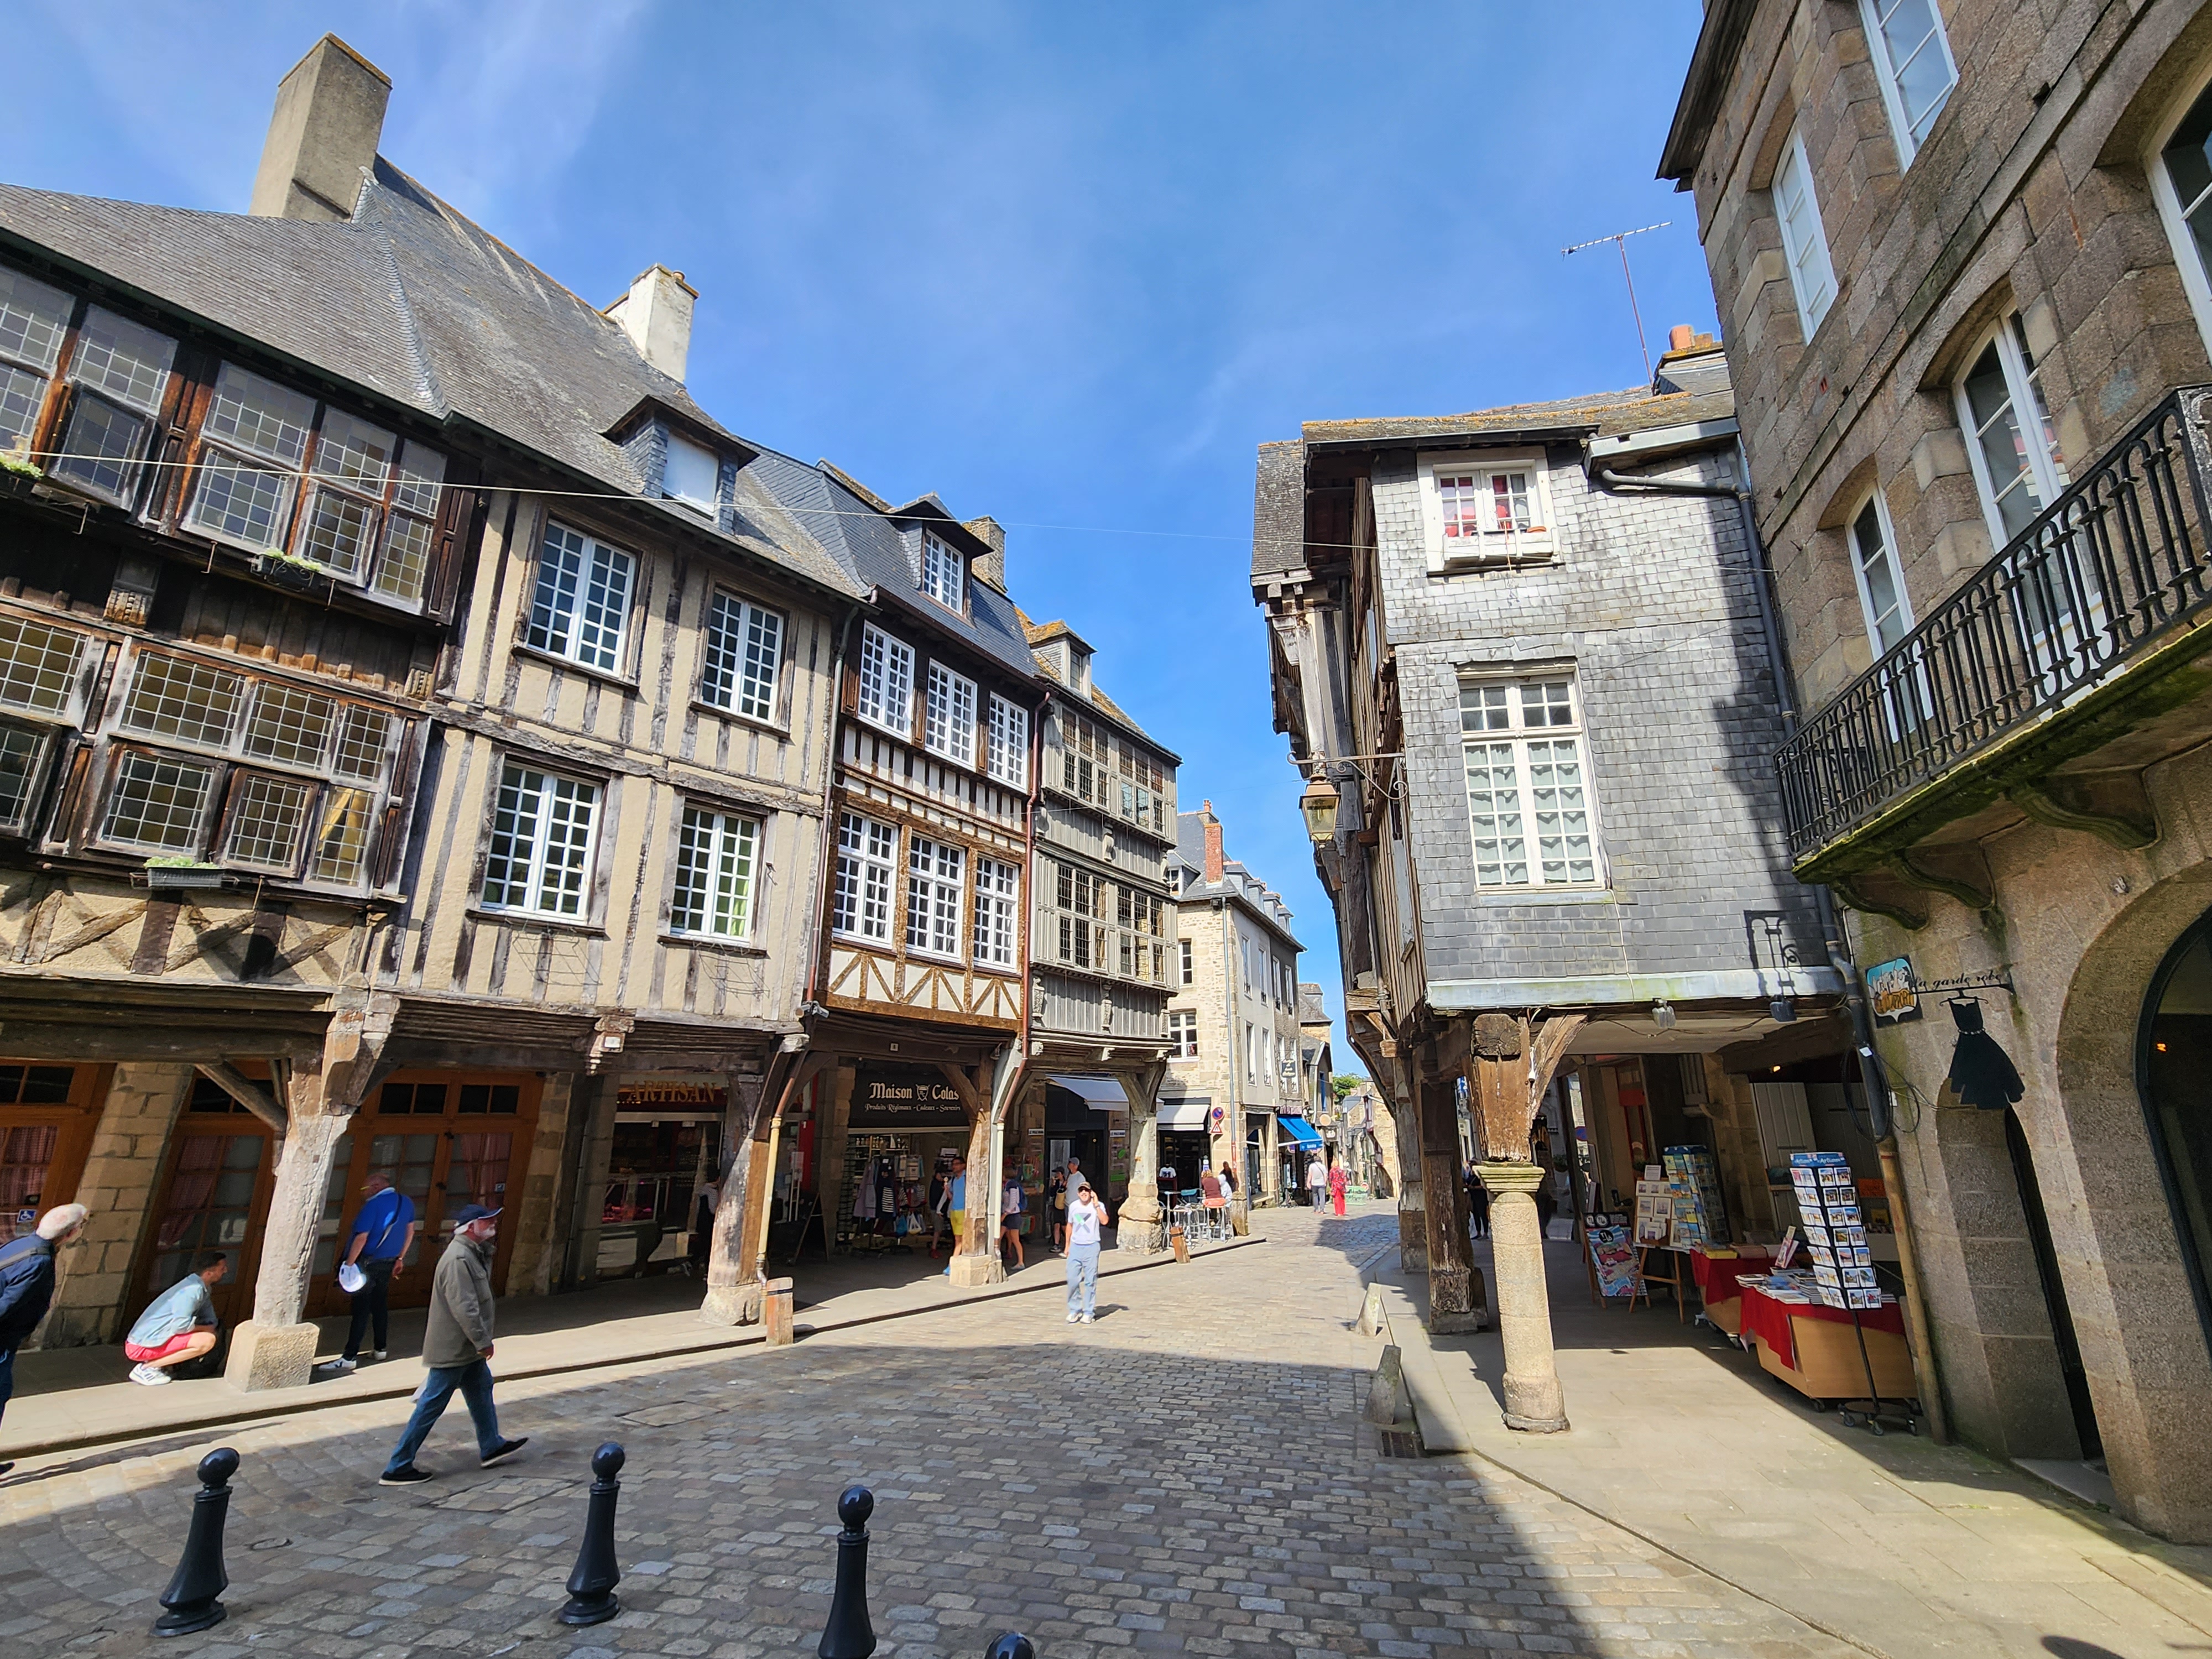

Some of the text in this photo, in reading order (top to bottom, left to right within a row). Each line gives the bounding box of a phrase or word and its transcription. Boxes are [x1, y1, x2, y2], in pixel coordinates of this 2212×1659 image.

[1932, 973, 1970, 990] garde
[1976, 971, 2001, 985] robe
[627, 1081, 716, 1102] ARTISAN
[869, 1082, 912, 1099] Maison
[932, 1084, 959, 1100] Colas
